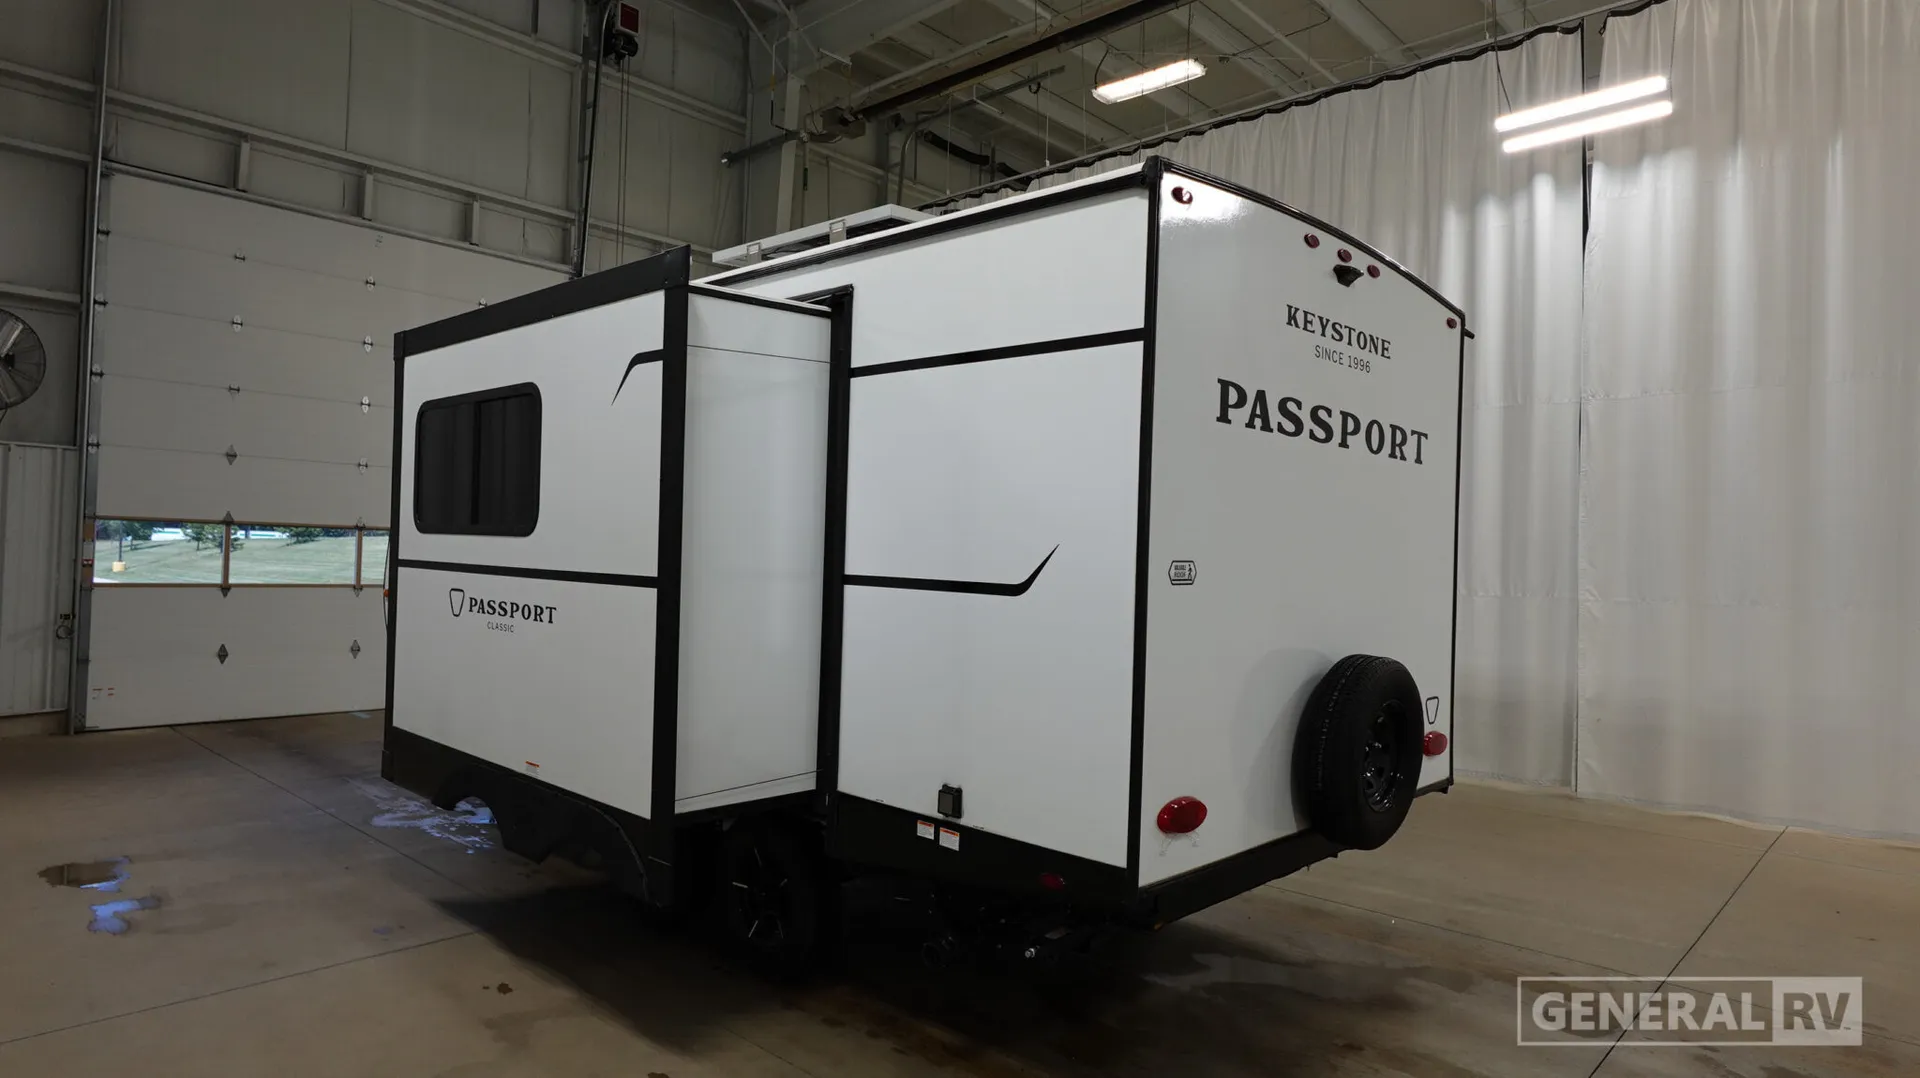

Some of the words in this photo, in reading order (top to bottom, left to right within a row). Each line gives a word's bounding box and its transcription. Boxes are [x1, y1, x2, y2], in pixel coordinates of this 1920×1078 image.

[1286, 304, 1391, 359] KEYSTONE
[1314, 345, 1344, 366] SINCE
[1348, 355, 1371, 374] 1996
[1216, 378, 1428, 465] PASSPORT
[469, 597, 557, 624] PASSPORT
[487, 621, 514, 633] CLASSIC
